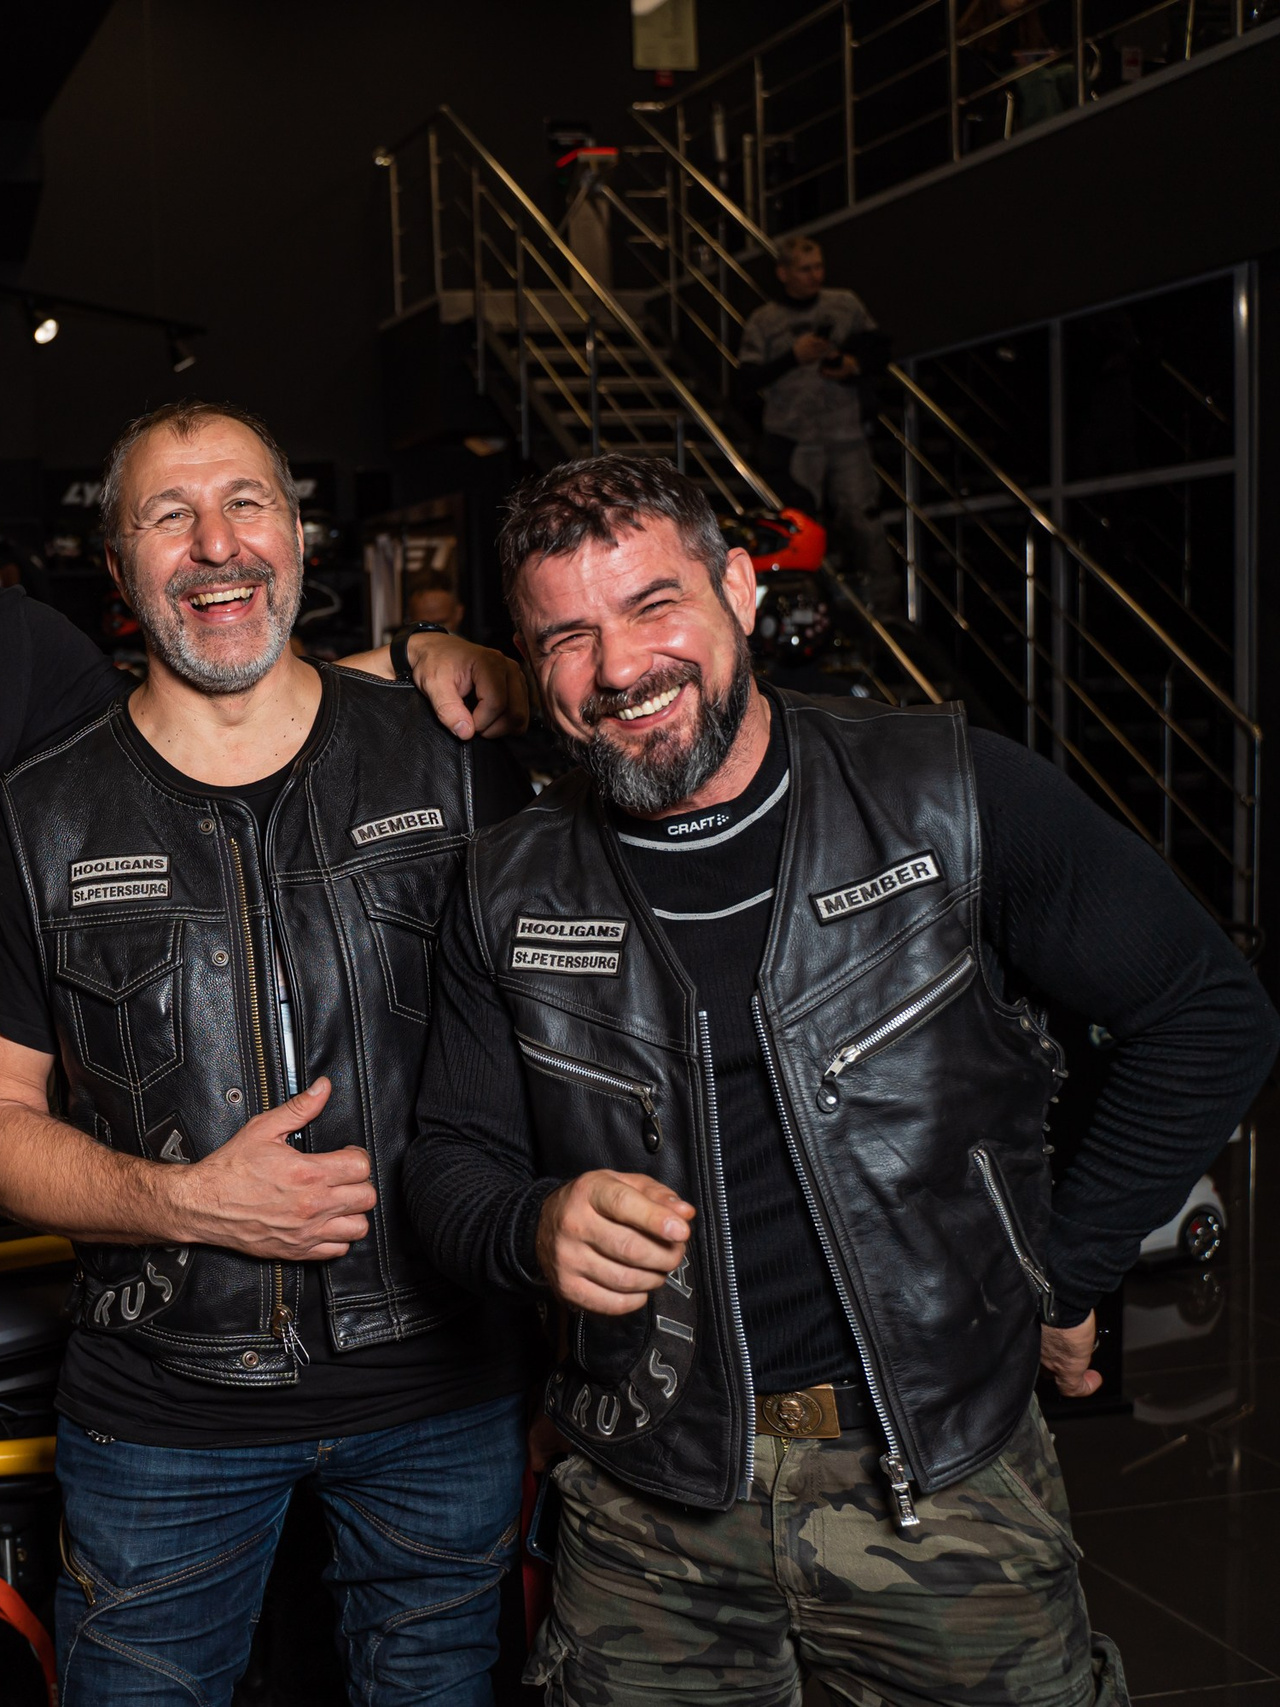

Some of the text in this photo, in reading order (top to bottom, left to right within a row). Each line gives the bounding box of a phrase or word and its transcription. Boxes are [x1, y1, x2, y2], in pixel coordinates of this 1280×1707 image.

[357, 811, 440, 841] MEMBER
[667, 815, 716, 837] CRAFT
[73, 858, 165, 877] HOOLIGANS
[74, 882, 167, 902] St.PETERSBURG
[823, 860, 931, 916] MEMBER
[520, 922, 622, 938] HOOLIGANS
[514, 950, 617, 970] St.PETERSBURG
[572, 1254, 694, 1436] RUSSIA
